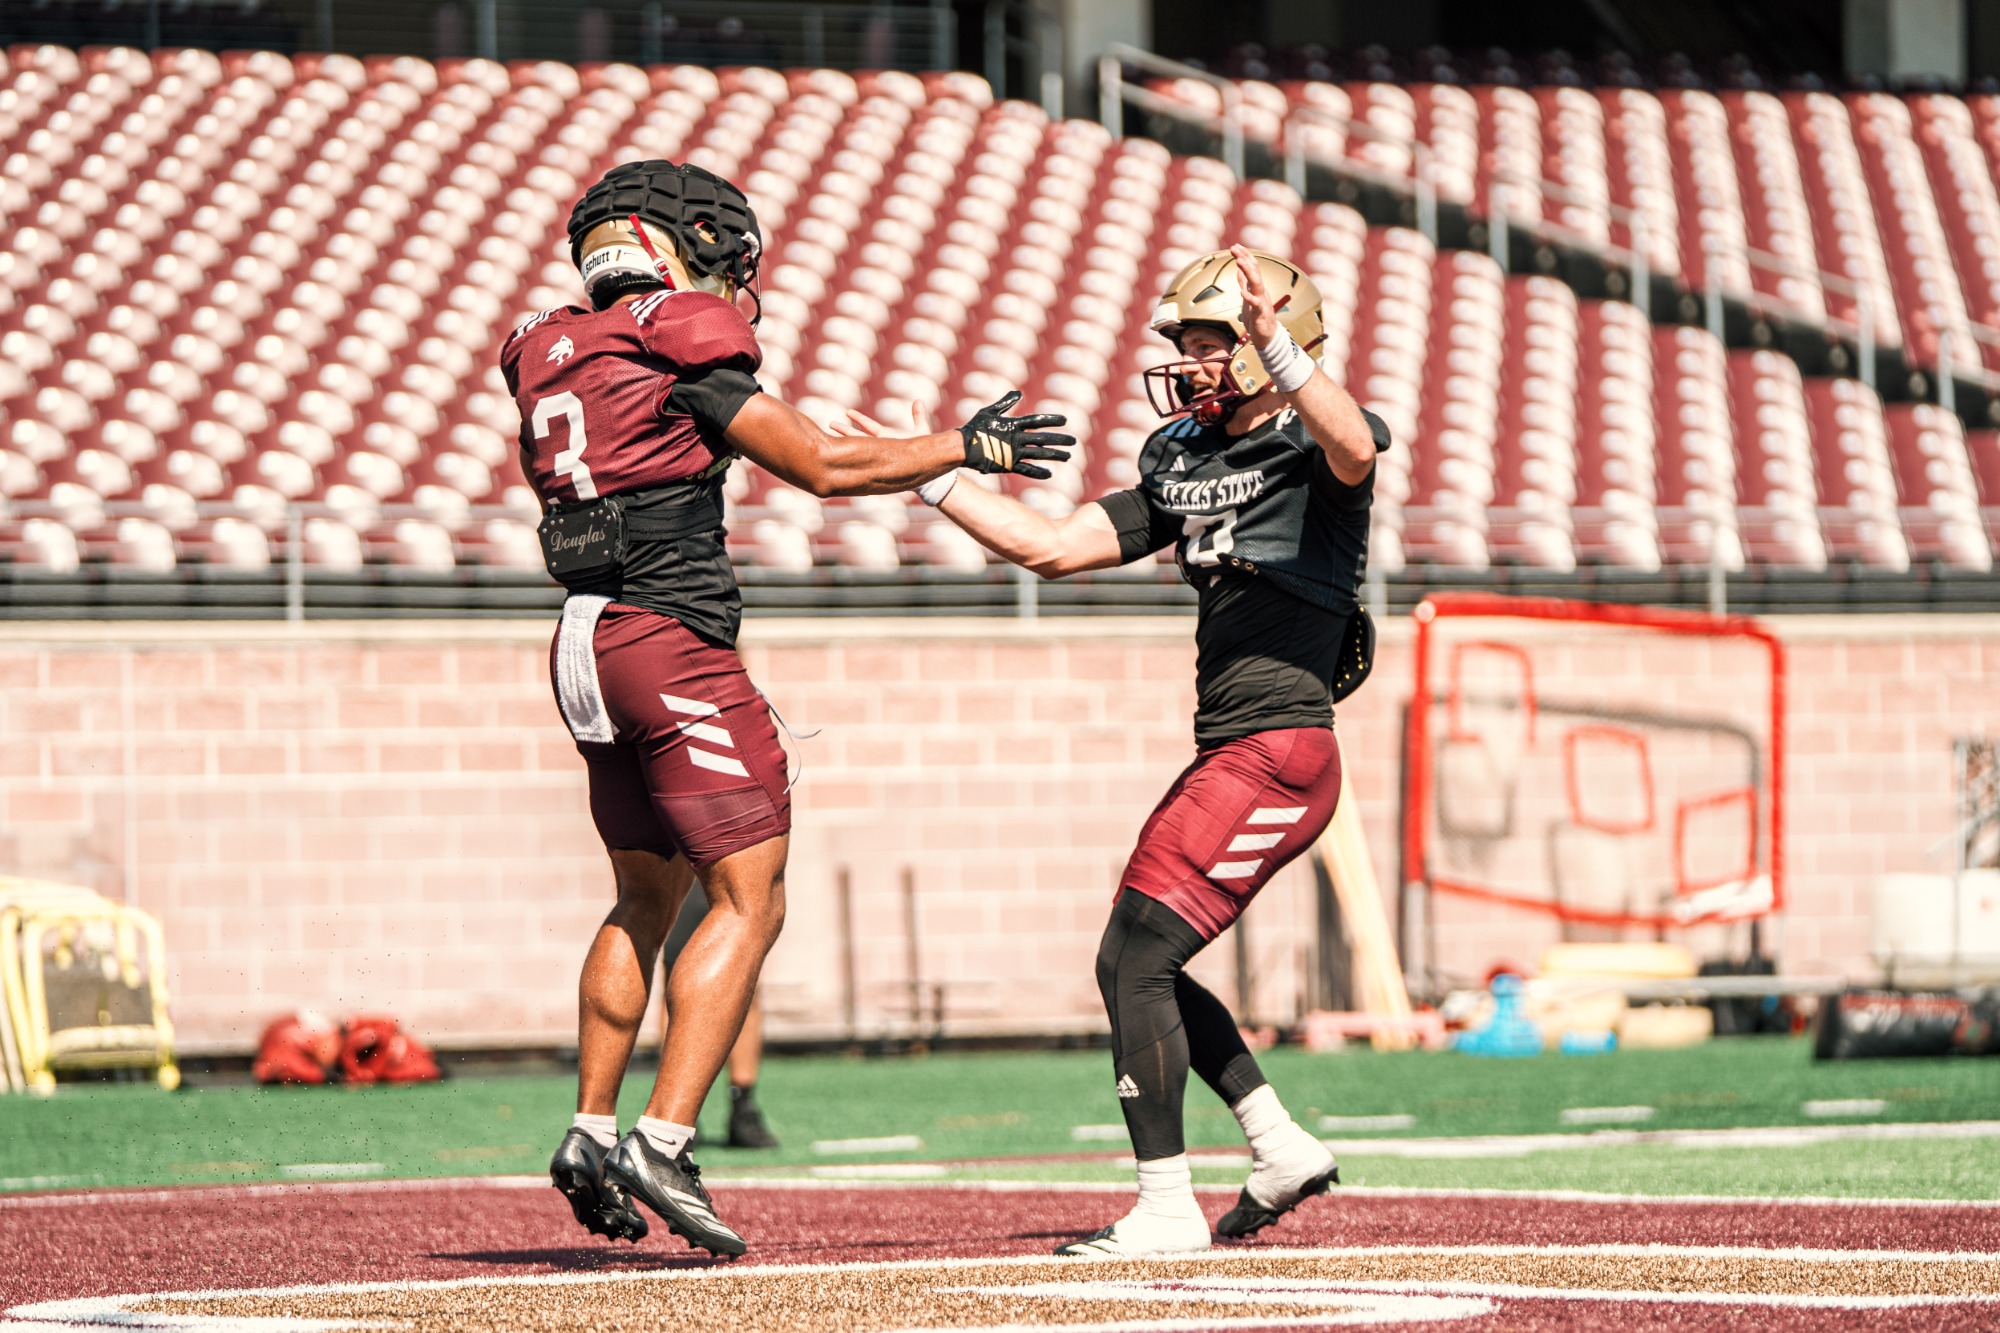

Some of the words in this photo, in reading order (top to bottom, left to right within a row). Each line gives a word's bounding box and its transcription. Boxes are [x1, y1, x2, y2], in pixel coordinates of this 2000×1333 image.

[585, 251, 610, 275] schutt
[532, 390, 598, 505] 3
[1162, 479, 1218, 510] TEXAS
[1216, 470, 1264, 508] STATE
[550, 523, 606, 555] Douglas
